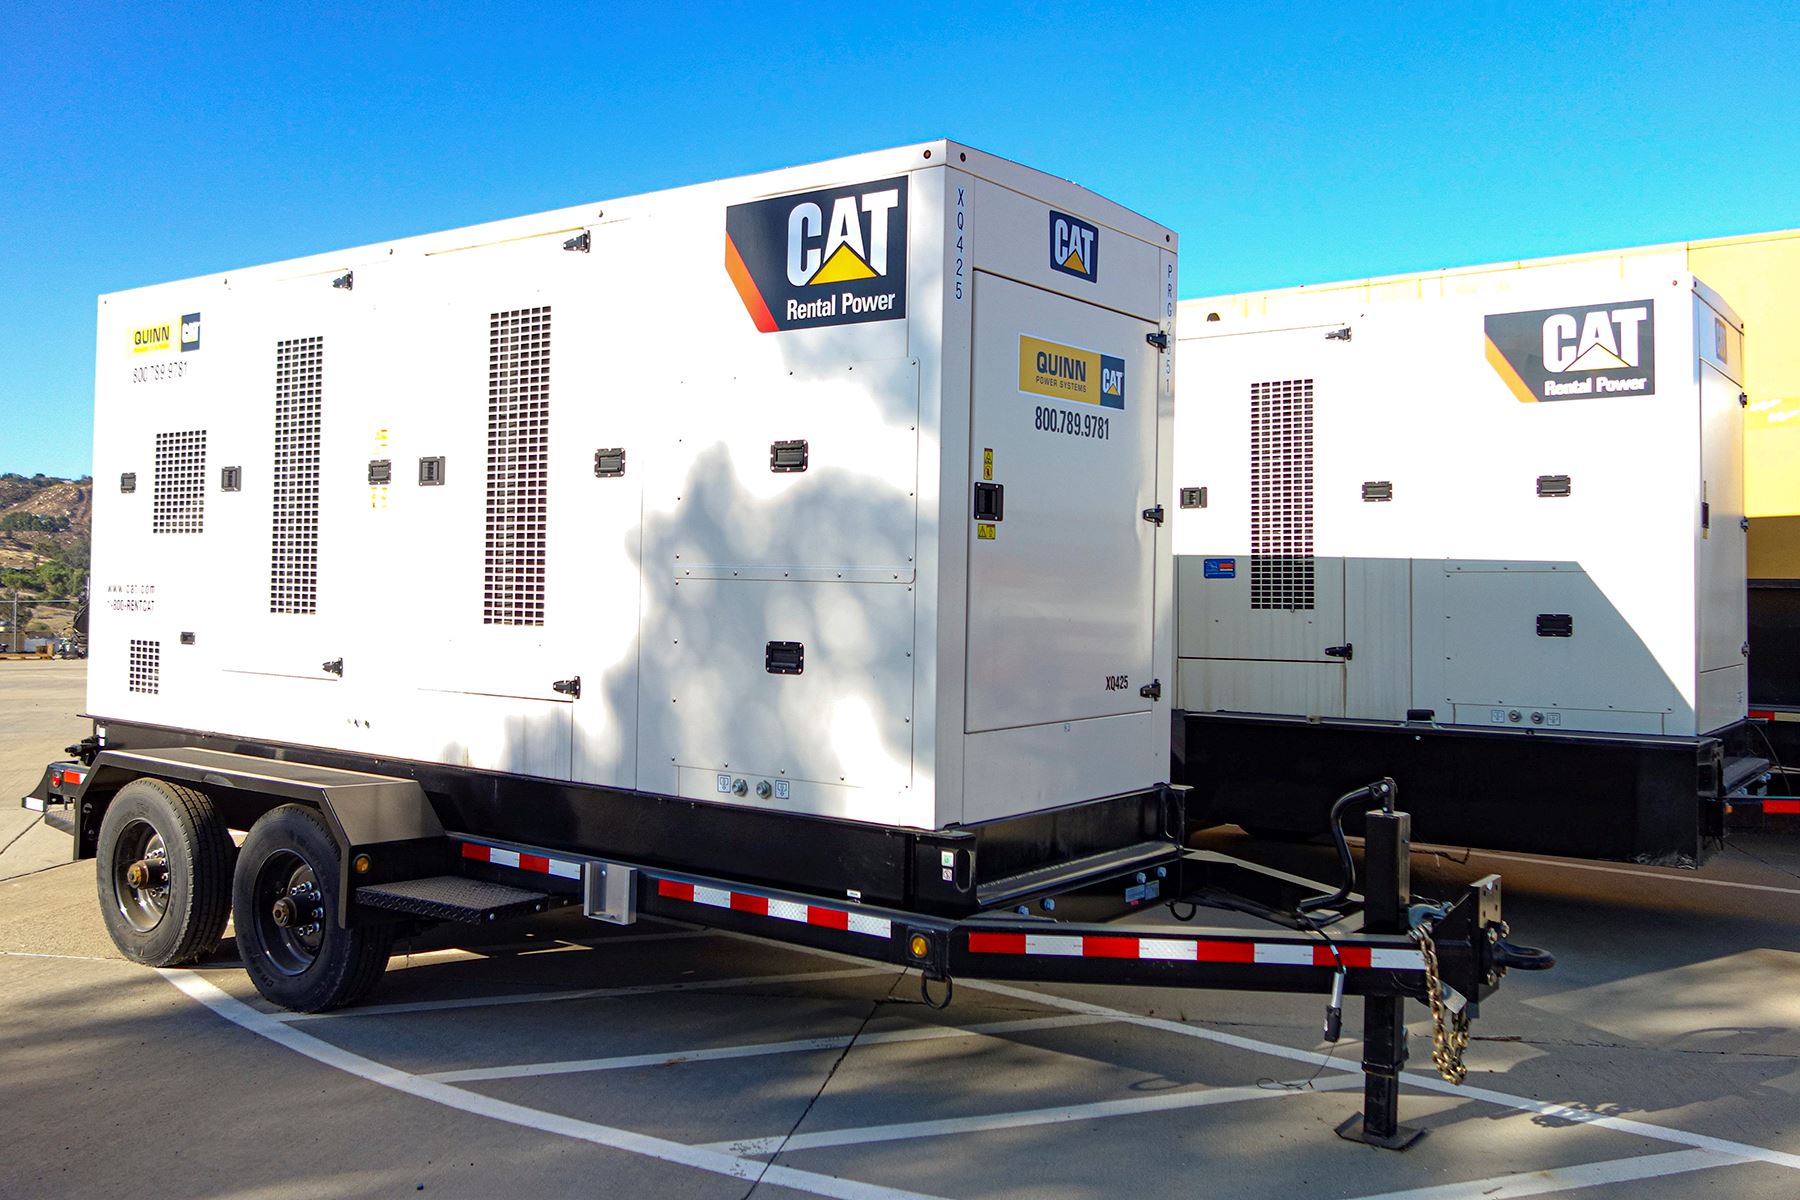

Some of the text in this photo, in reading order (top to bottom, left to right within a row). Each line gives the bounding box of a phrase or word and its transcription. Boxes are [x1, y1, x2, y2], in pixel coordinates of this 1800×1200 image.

[787, 189, 899, 287] CAT
[956, 187, 964, 300] XQ425
[1054, 218, 1094, 275] CAT
[786, 292, 896, 321] Rental Power
[134, 325, 170, 346] QUINN
[1542, 307, 1648, 374] CAT
[133, 361, 188, 384] 8007899781
[1036, 351, 1087, 382] QUINN
[1035, 375, 1087, 393] POWER SYSTEMS
[1102, 368, 1124, 396] CAT
[1544, 376, 1648, 397] Rental Power
[1035, 405, 1109, 441] 800.789.9781
[1105, 675, 1128, 691] XQ425
